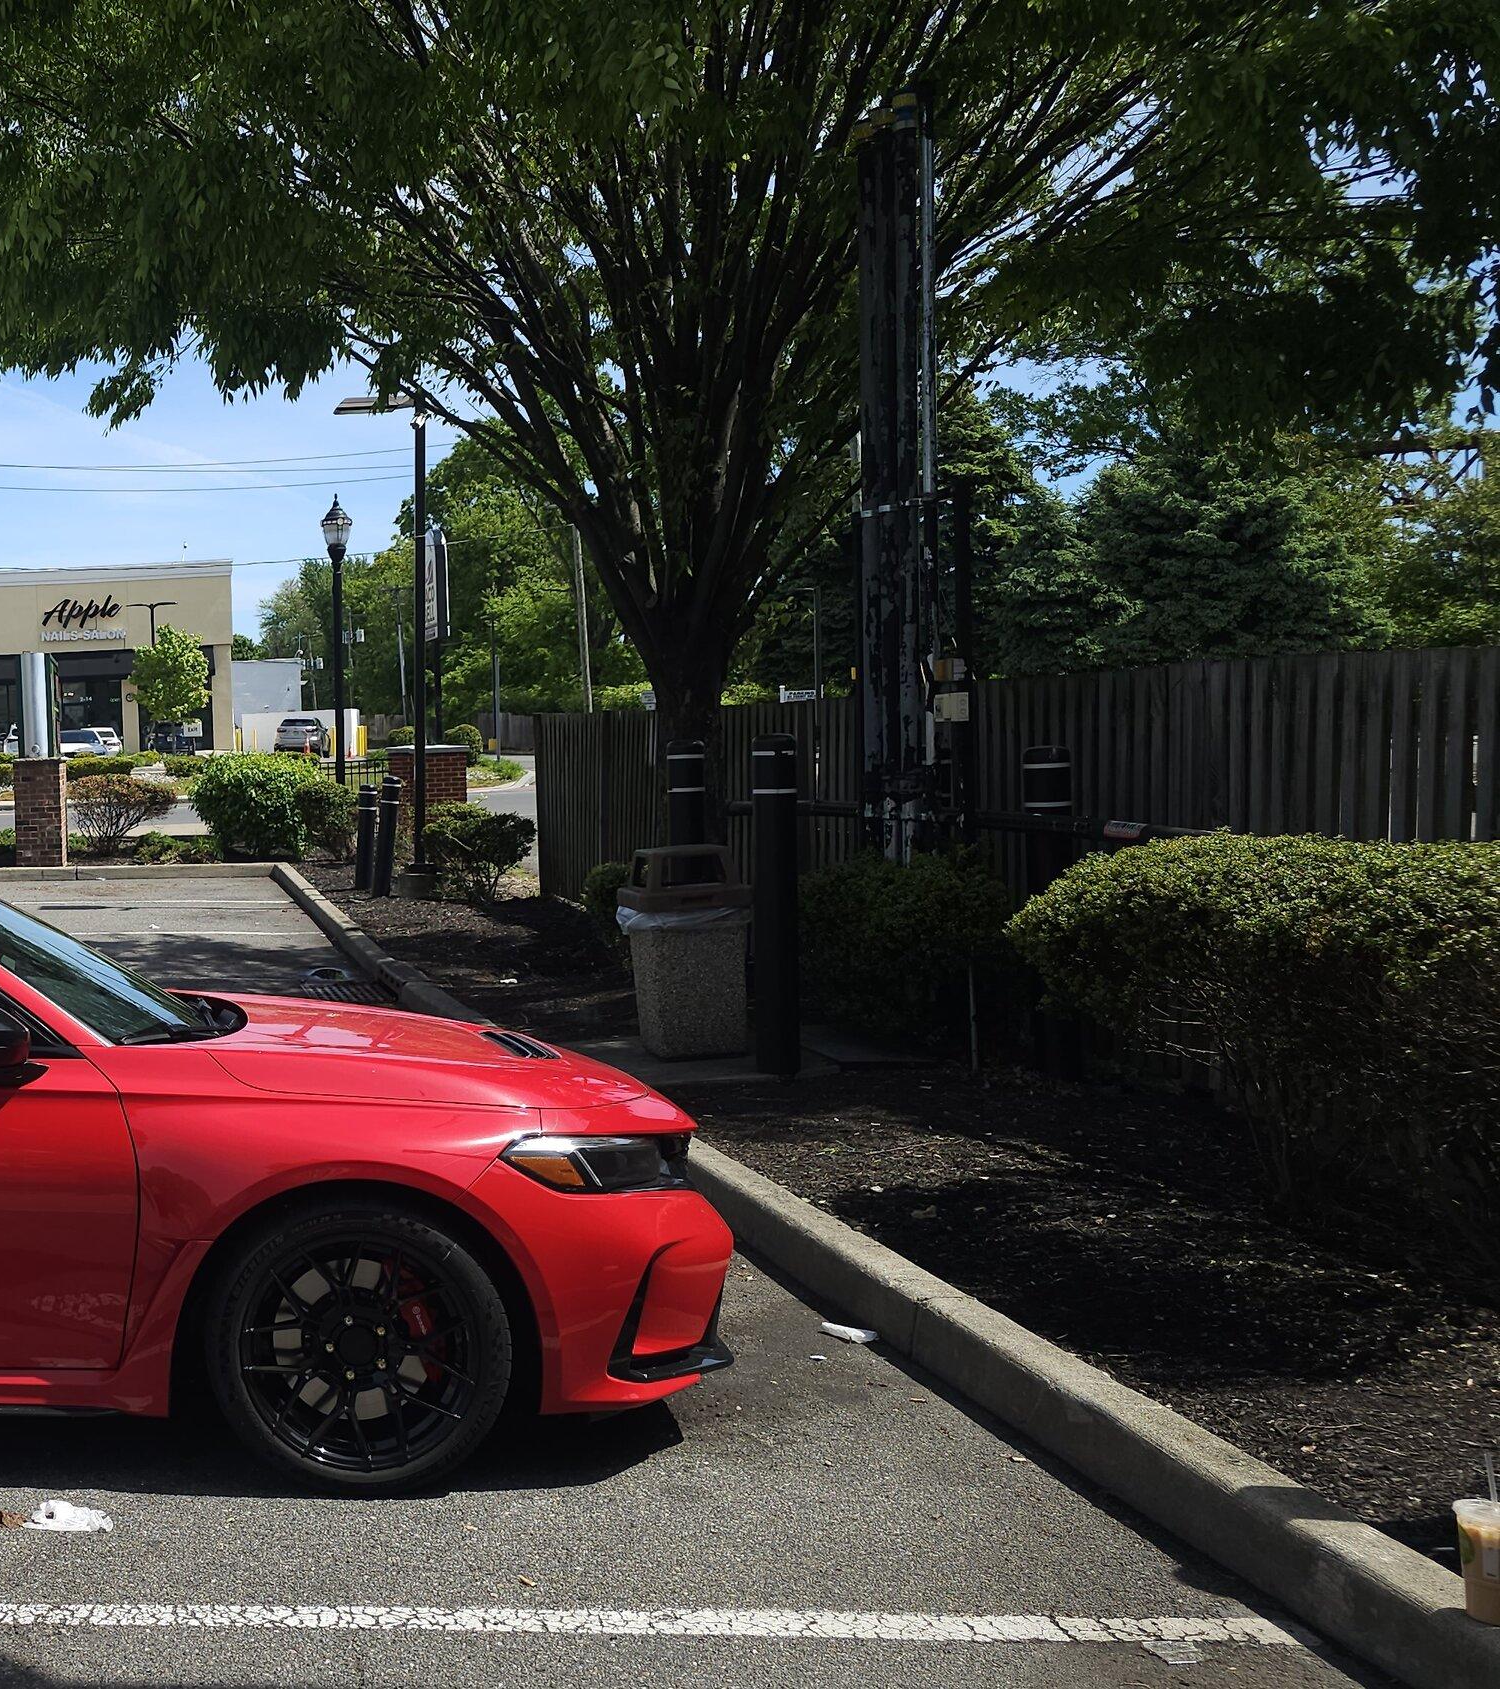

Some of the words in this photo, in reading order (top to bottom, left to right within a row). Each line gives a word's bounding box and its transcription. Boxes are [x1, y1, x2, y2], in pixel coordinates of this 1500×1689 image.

[41, 594, 123, 630] Apple
[41, 630, 78, 642] NAILS
[83, 629, 125, 641] SALON
